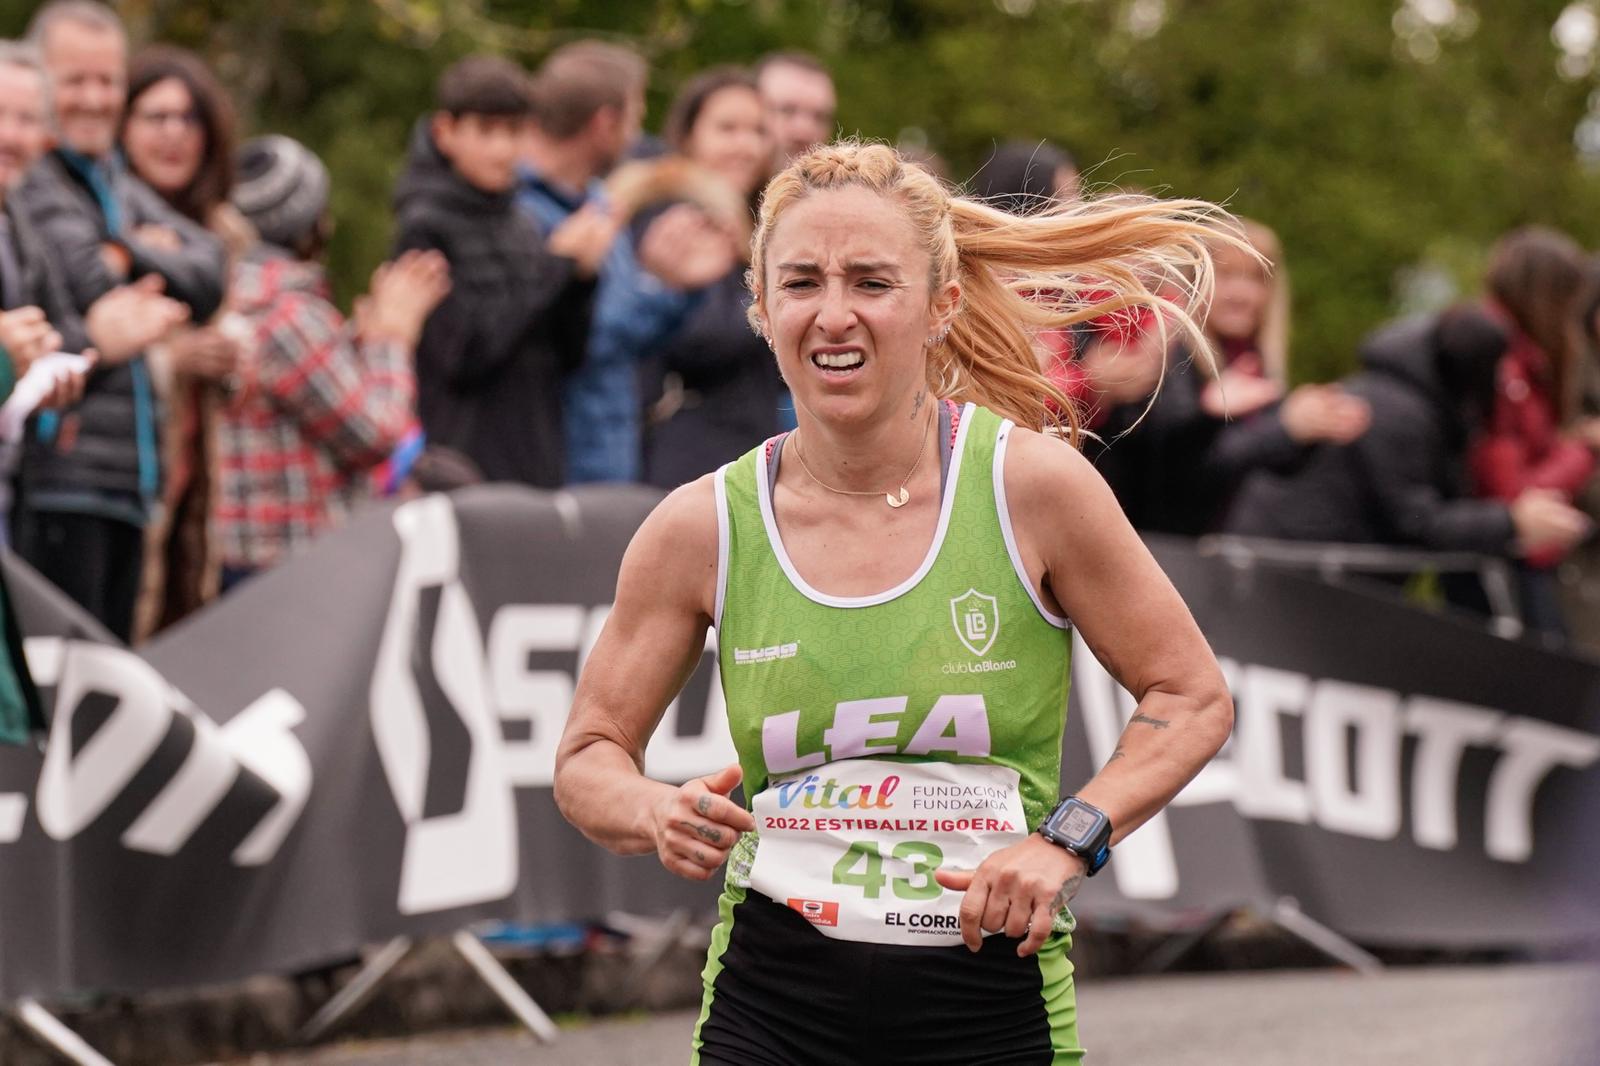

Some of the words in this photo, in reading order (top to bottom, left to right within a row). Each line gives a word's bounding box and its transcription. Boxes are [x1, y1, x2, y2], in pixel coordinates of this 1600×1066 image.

[761, 694, 992, 774] LEA
[774, 775, 901, 810] Vital
[913, 786, 1007, 799] FUNDACIÓN
[765, 817, 810, 831] 2022
[815, 818, 928, 831] ESTIBALIZ
[933, 818, 1015, 832] IGOERA
[832, 840, 944, 900] 43
[885, 912, 906, 926] EL
